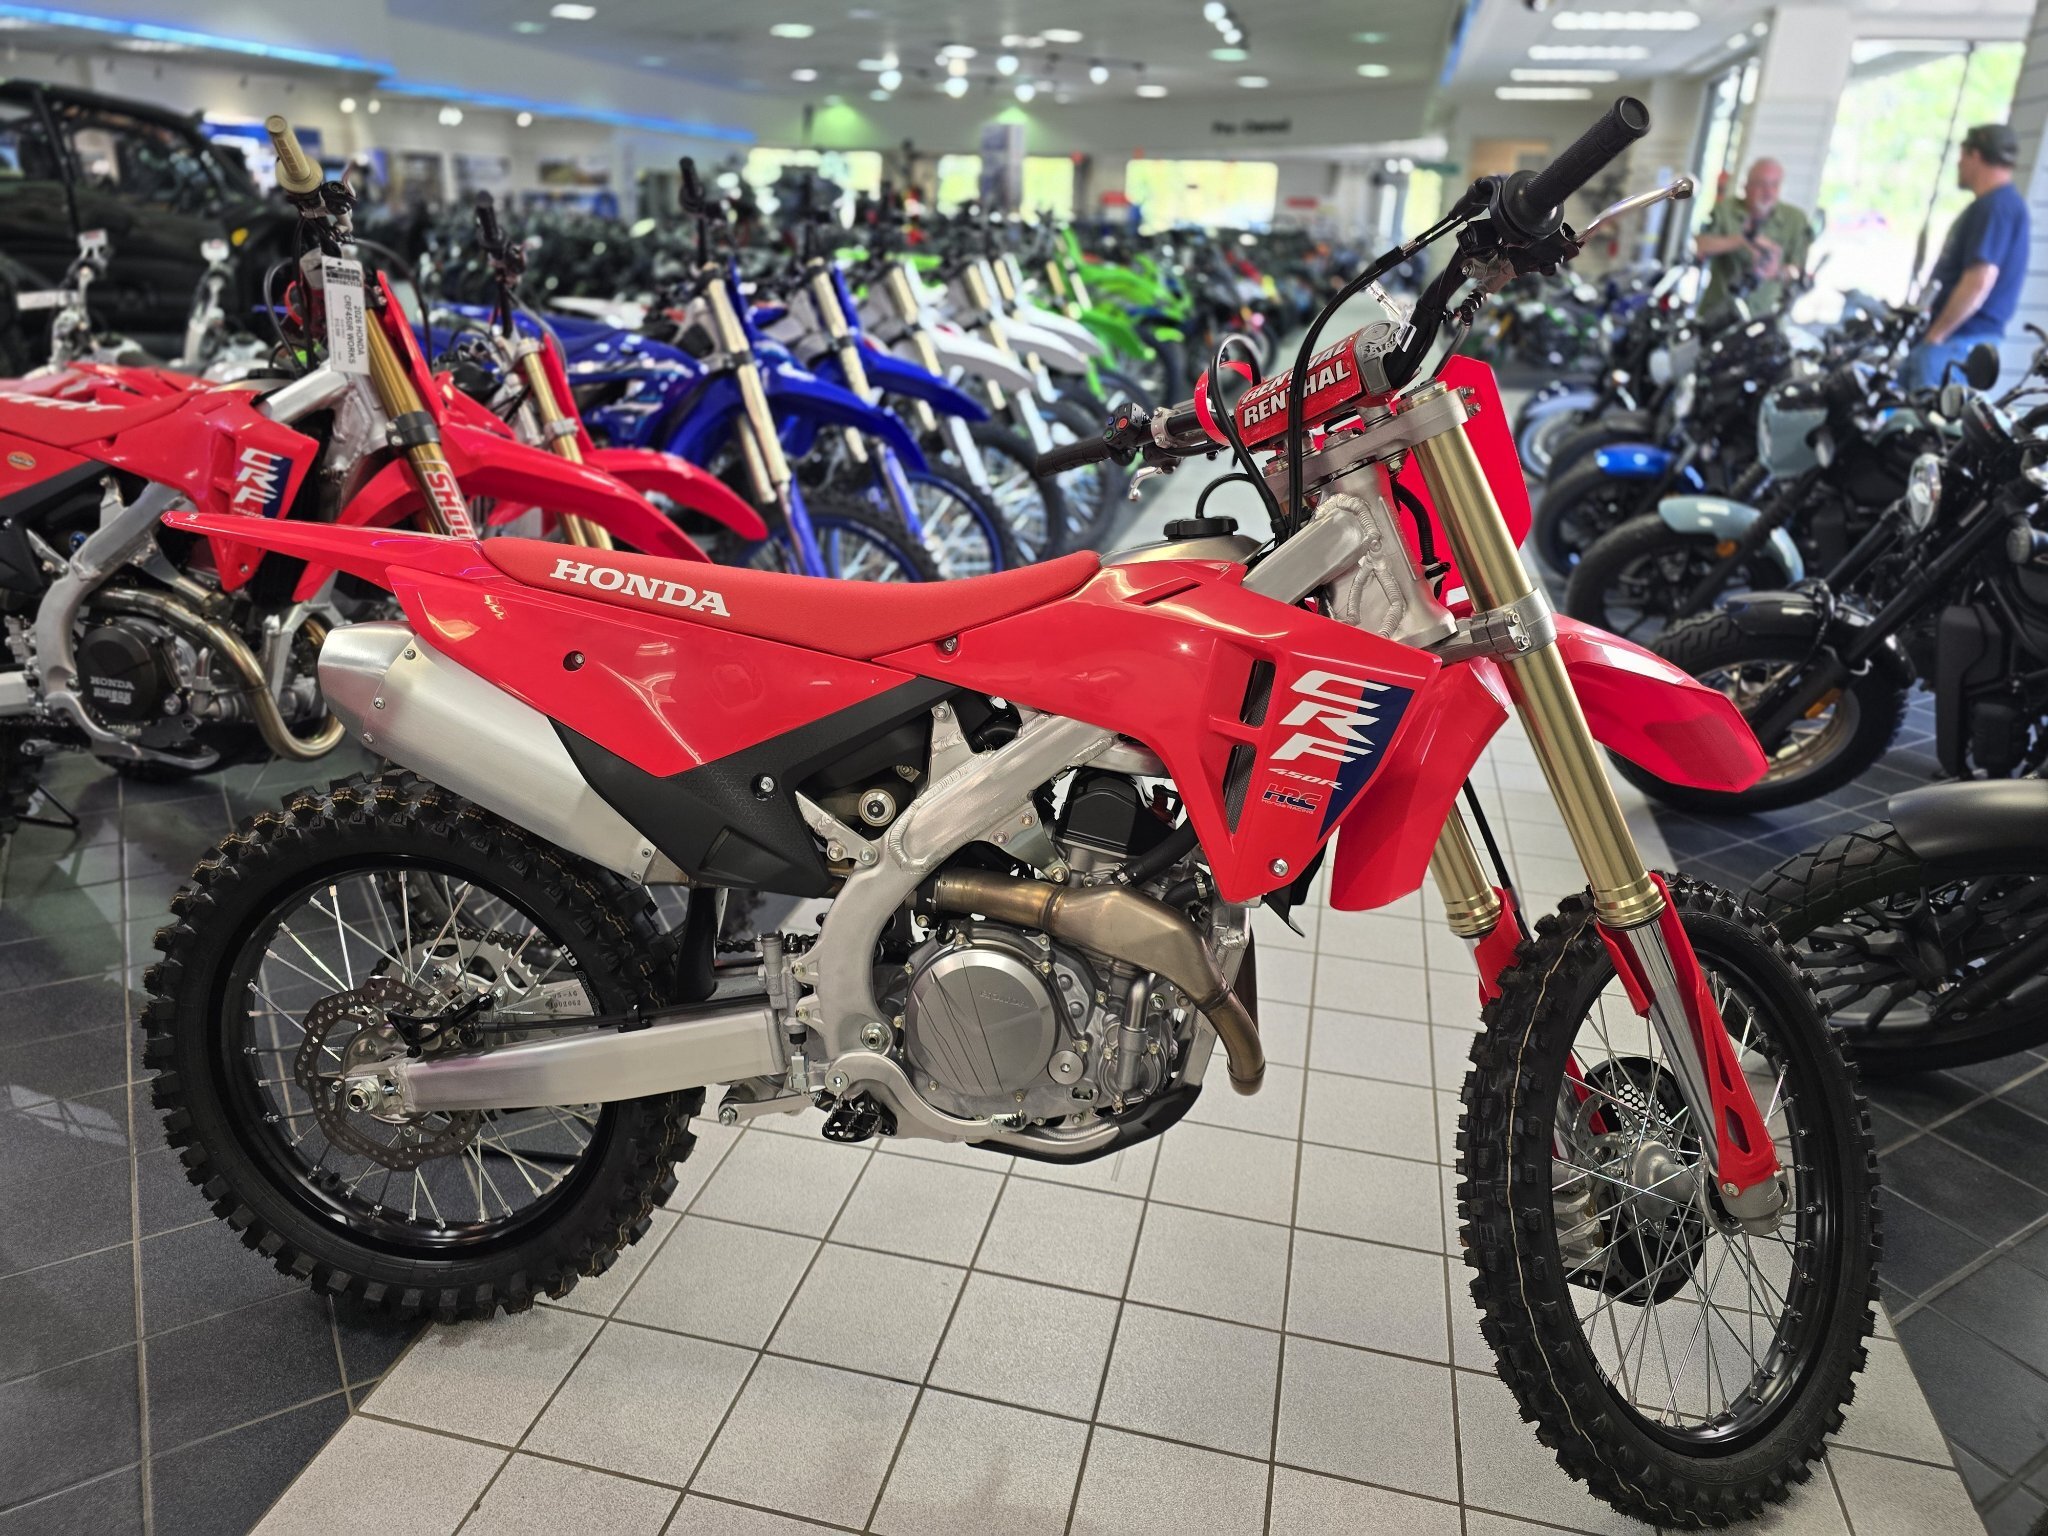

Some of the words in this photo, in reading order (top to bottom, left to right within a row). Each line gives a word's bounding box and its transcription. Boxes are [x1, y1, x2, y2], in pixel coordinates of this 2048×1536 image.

[343, 294, 354, 331] CRF450R
[346, 332, 356, 365] WORKS
[355, 324, 365, 356] HONDA
[1242, 341, 1347, 404] RENHAL
[1244, 359, 1351, 429] RENHAL
[231, 448, 283, 504] CRF
[549, 558, 731, 618] HONDA
[90, 676, 135, 691] HONDA
[1269, 669, 1392, 764] CRF
[1268, 767, 1344, 791] 450R
[1262, 782, 1323, 812] HRC
[560, 944, 578, 967] DID
